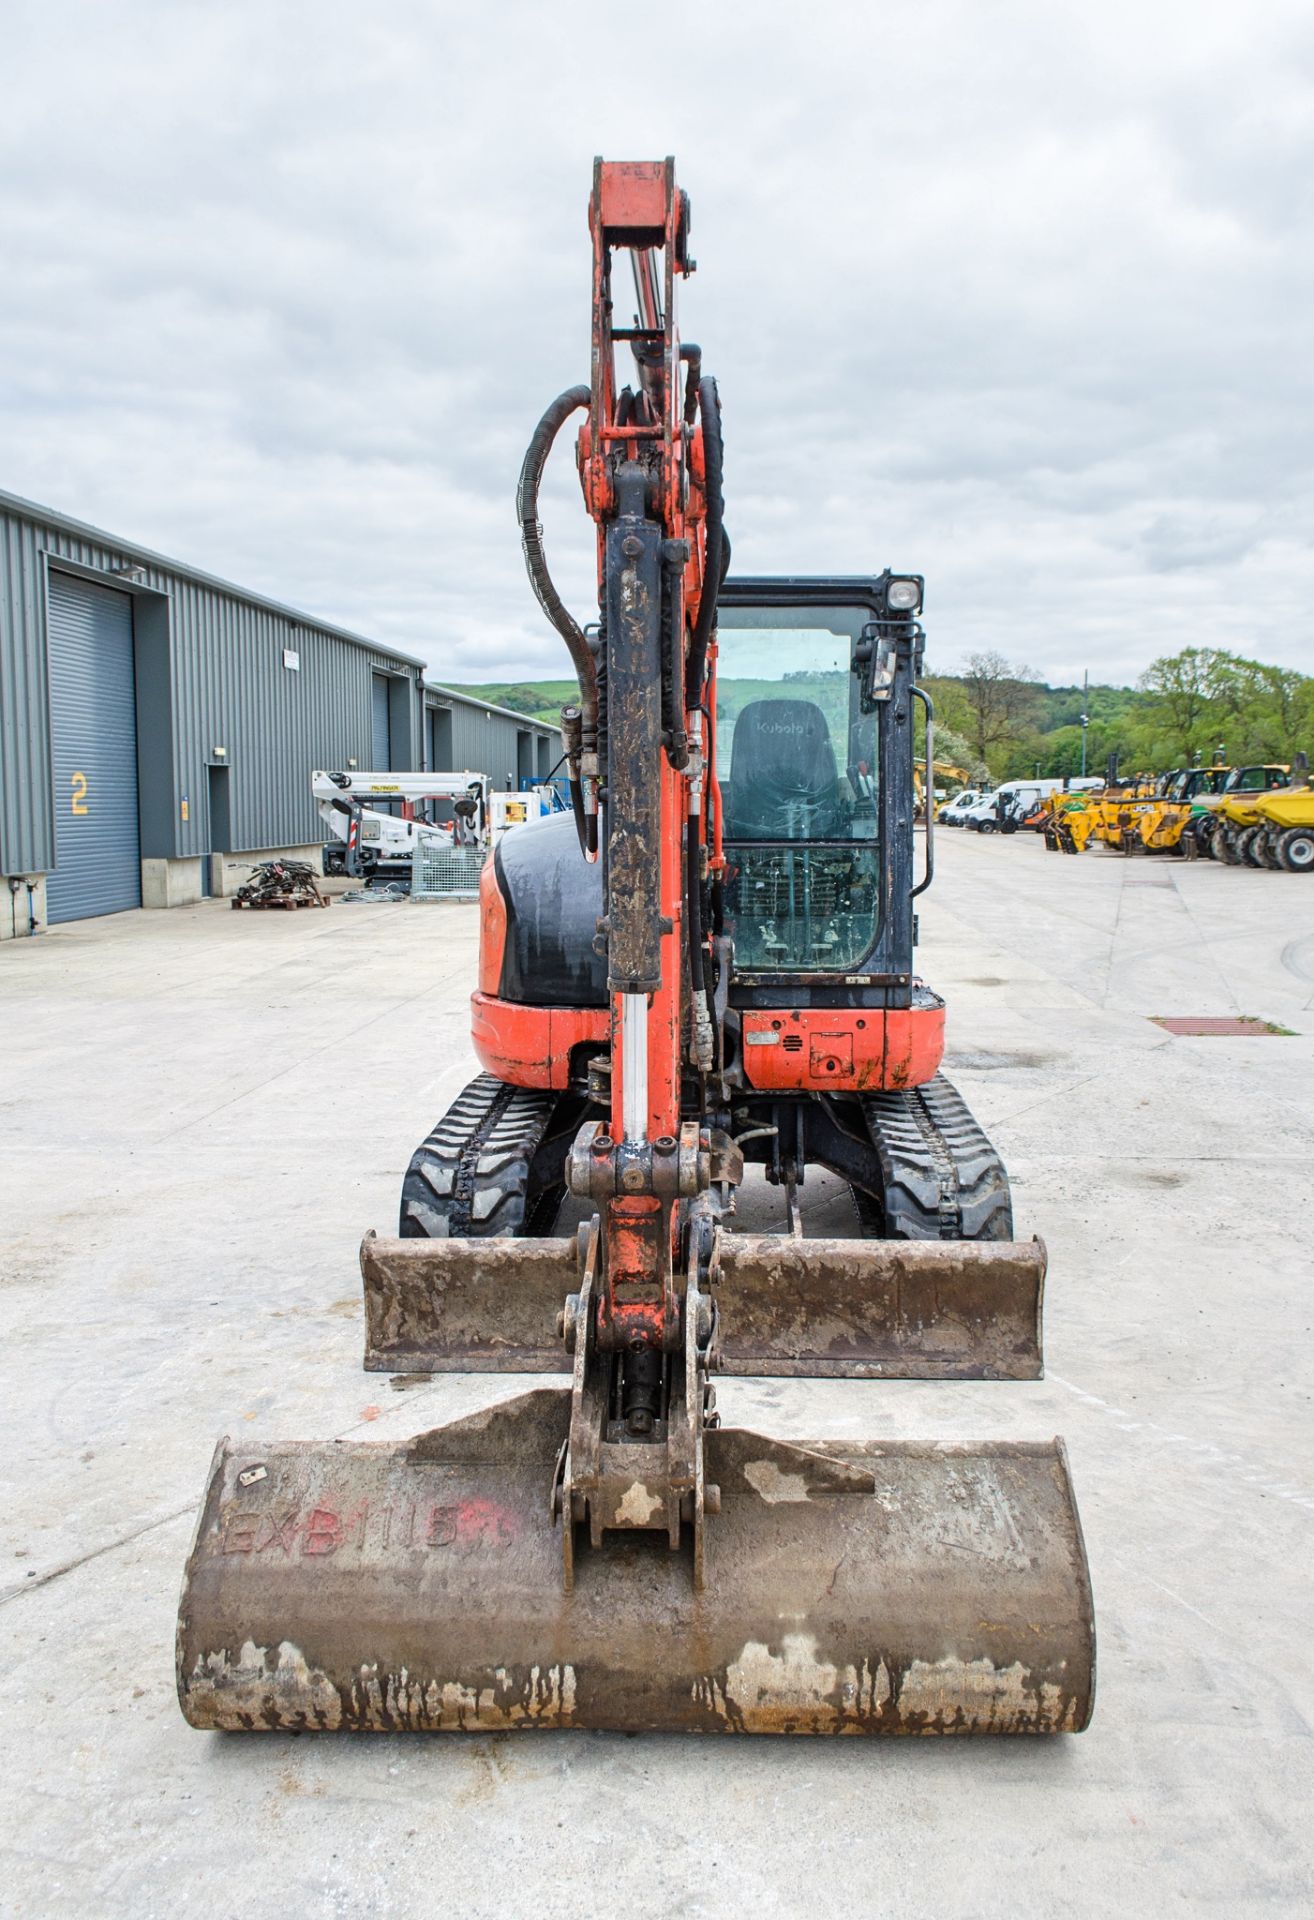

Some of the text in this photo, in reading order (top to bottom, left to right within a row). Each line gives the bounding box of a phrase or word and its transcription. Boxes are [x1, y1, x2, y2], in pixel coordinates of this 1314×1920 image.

[756, 722, 804, 734] Kubota
[71, 771, 88, 815] 2
[1133, 804, 1155, 813] JCB
